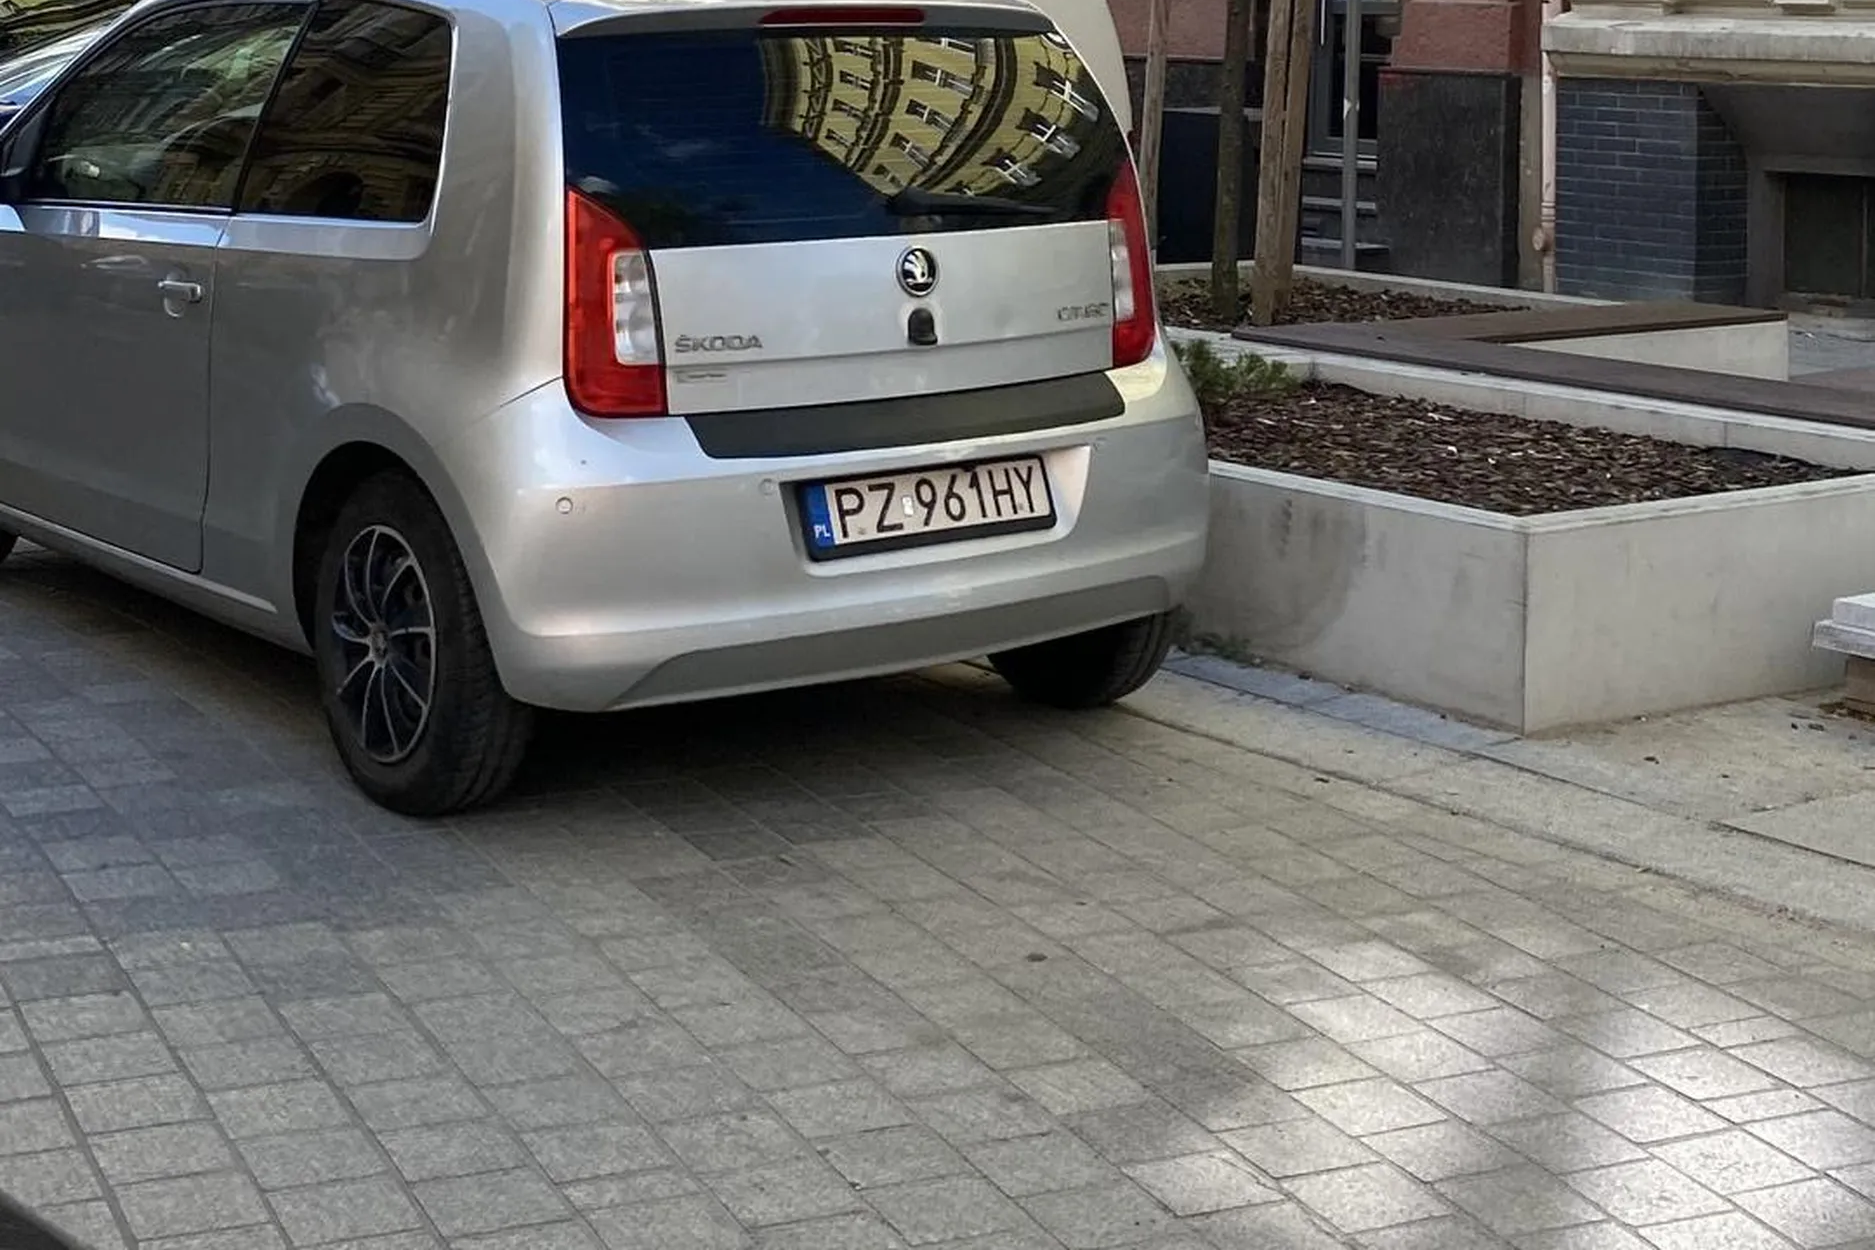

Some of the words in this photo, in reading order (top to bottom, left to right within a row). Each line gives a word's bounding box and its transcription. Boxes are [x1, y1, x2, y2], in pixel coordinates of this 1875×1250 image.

[675, 334, 763, 354] ŠKODA
[834, 481, 904, 539] PZ
[914, 465, 1035, 527] 961HY
[813, 525, 831, 539] PL
